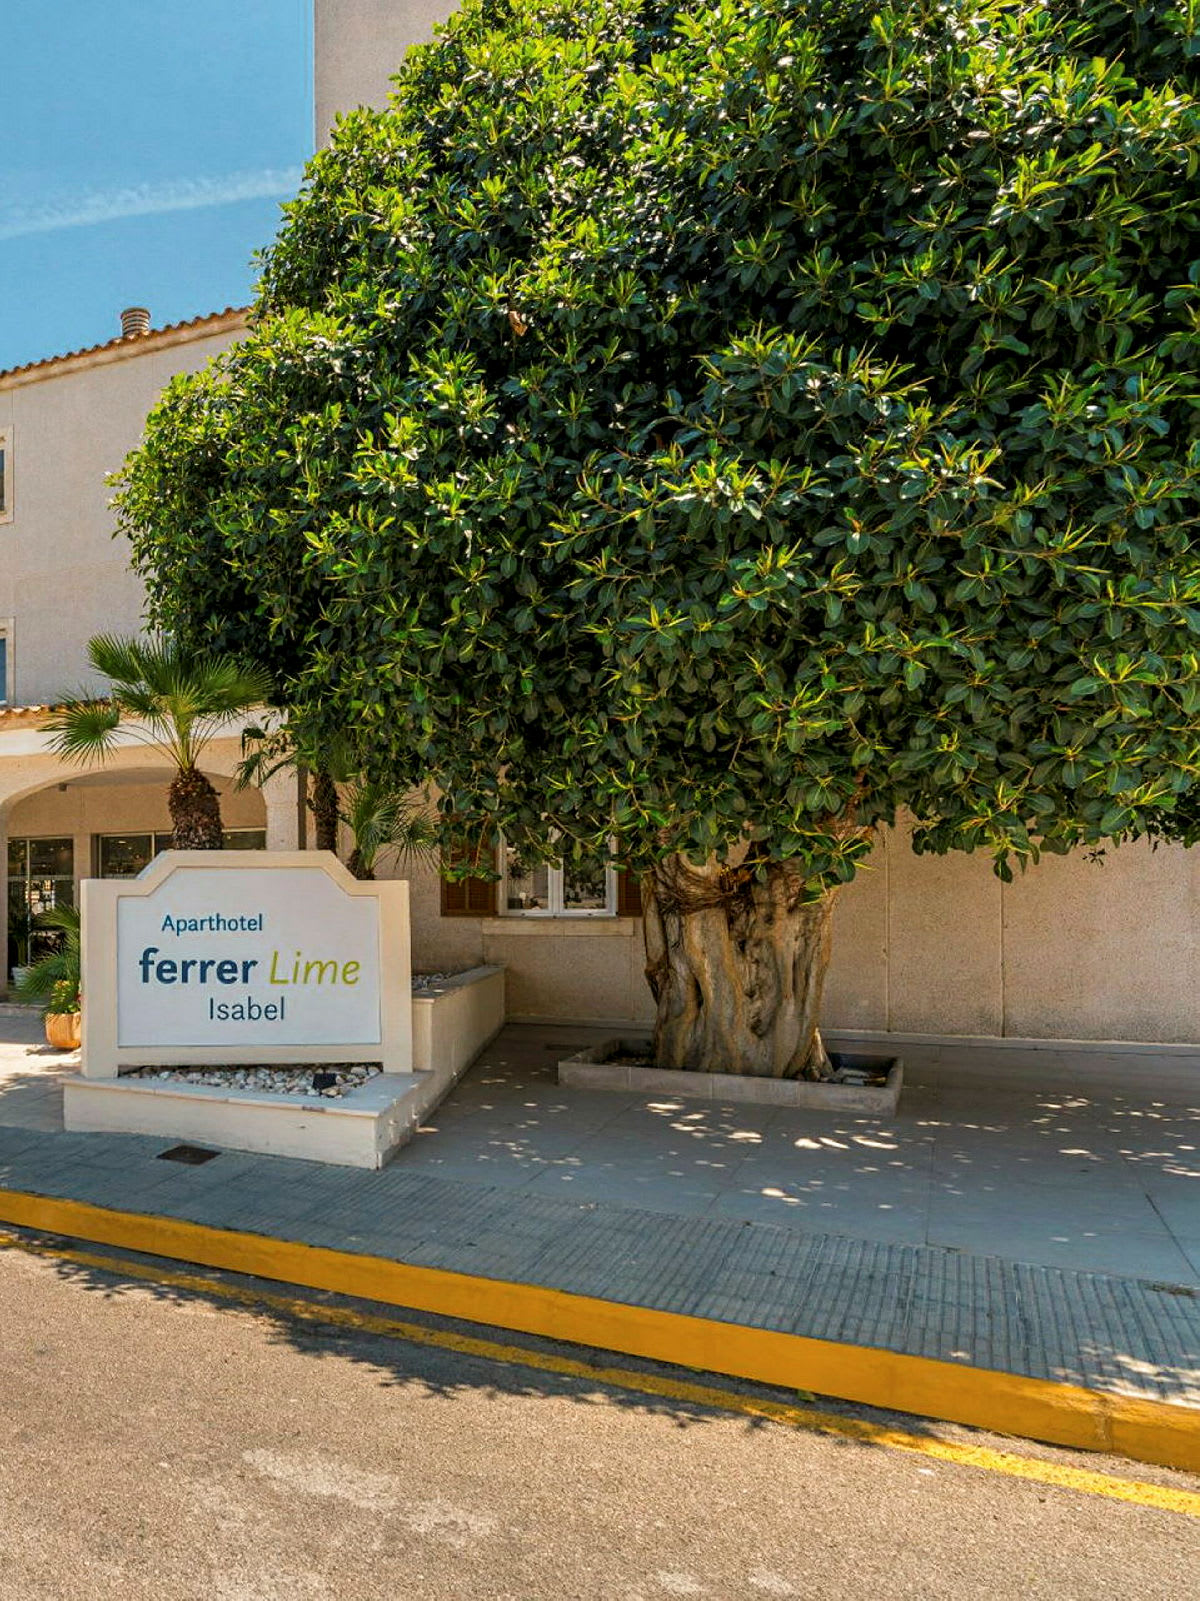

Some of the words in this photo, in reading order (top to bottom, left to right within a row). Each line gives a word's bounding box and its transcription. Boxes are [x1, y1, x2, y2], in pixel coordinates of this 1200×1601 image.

[161, 913, 263, 936] Aparthotel
[139, 947, 258, 985] ferrer
[269, 951, 361, 985] Lime
[209, 996, 285, 1021] Isabel
